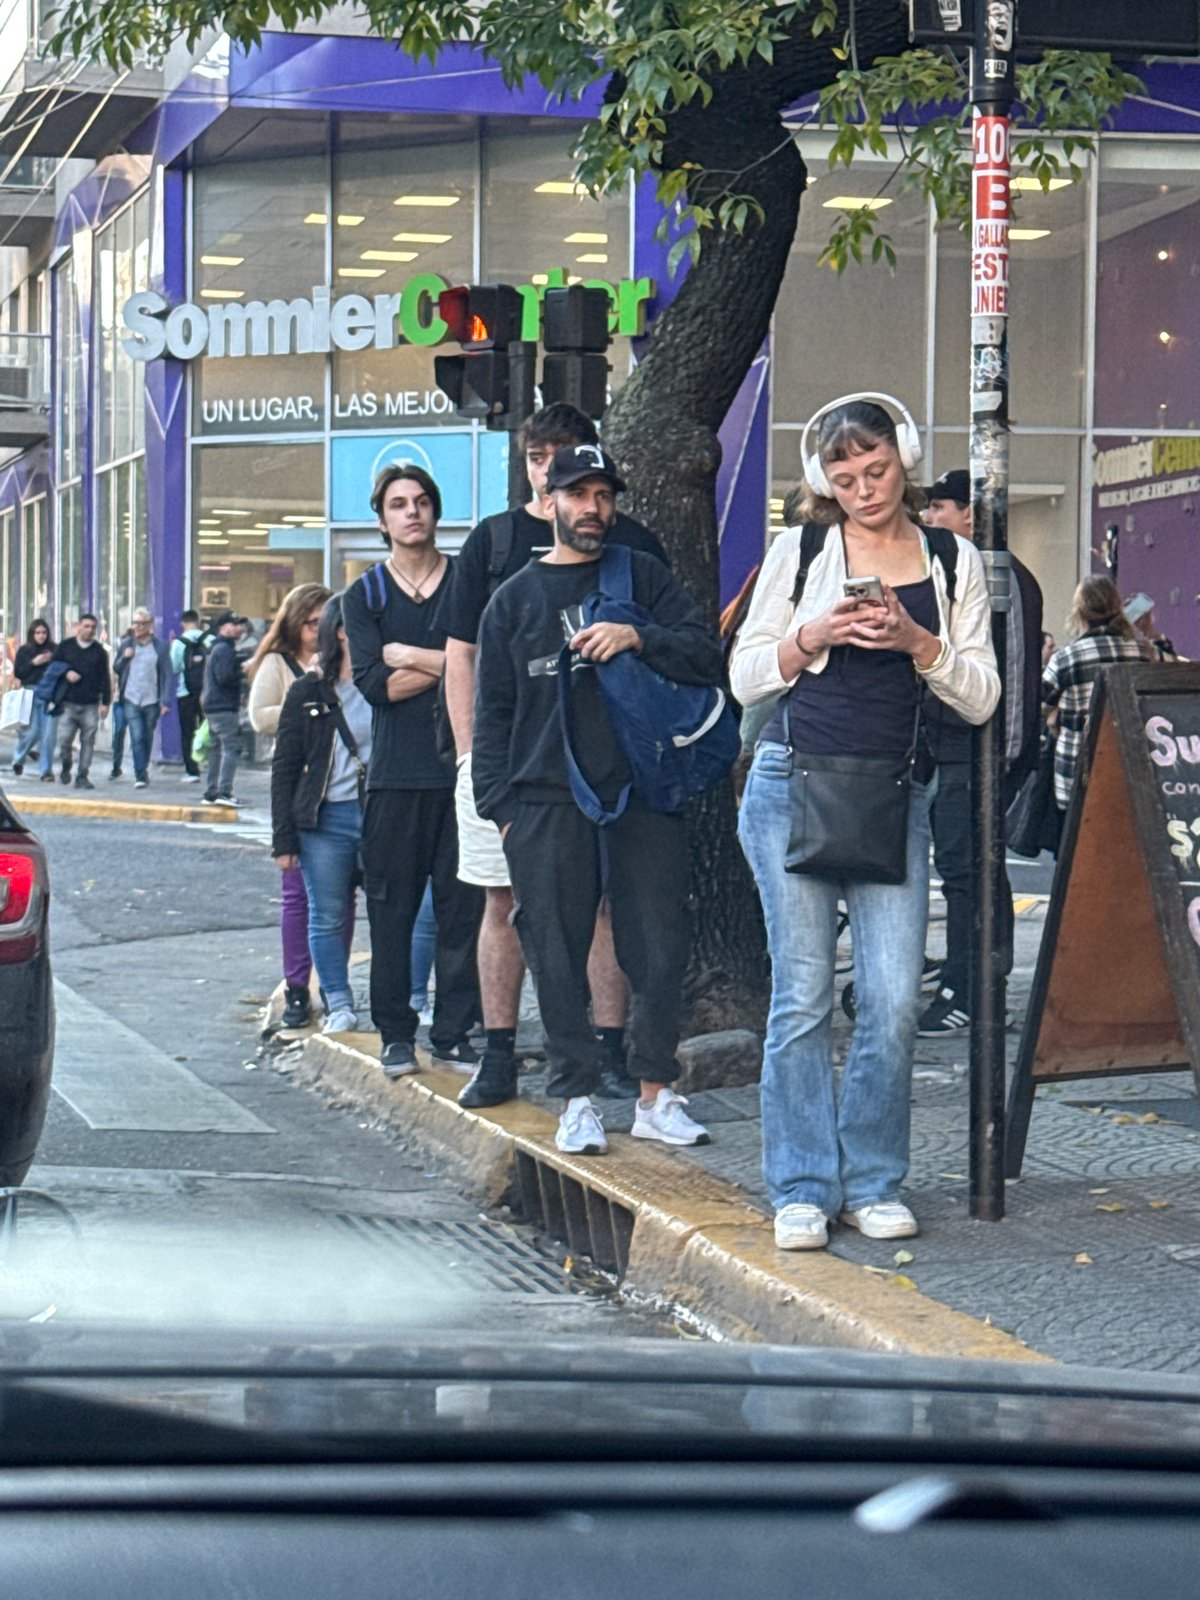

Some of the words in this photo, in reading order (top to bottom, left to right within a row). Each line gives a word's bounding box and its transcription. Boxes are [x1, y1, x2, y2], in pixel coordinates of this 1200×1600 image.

[201, 398, 234, 423] UN
[238, 395, 320, 423] LUGAR,
[334, 392, 378, 417] LAS
[384, 388, 454, 416] MEJO
